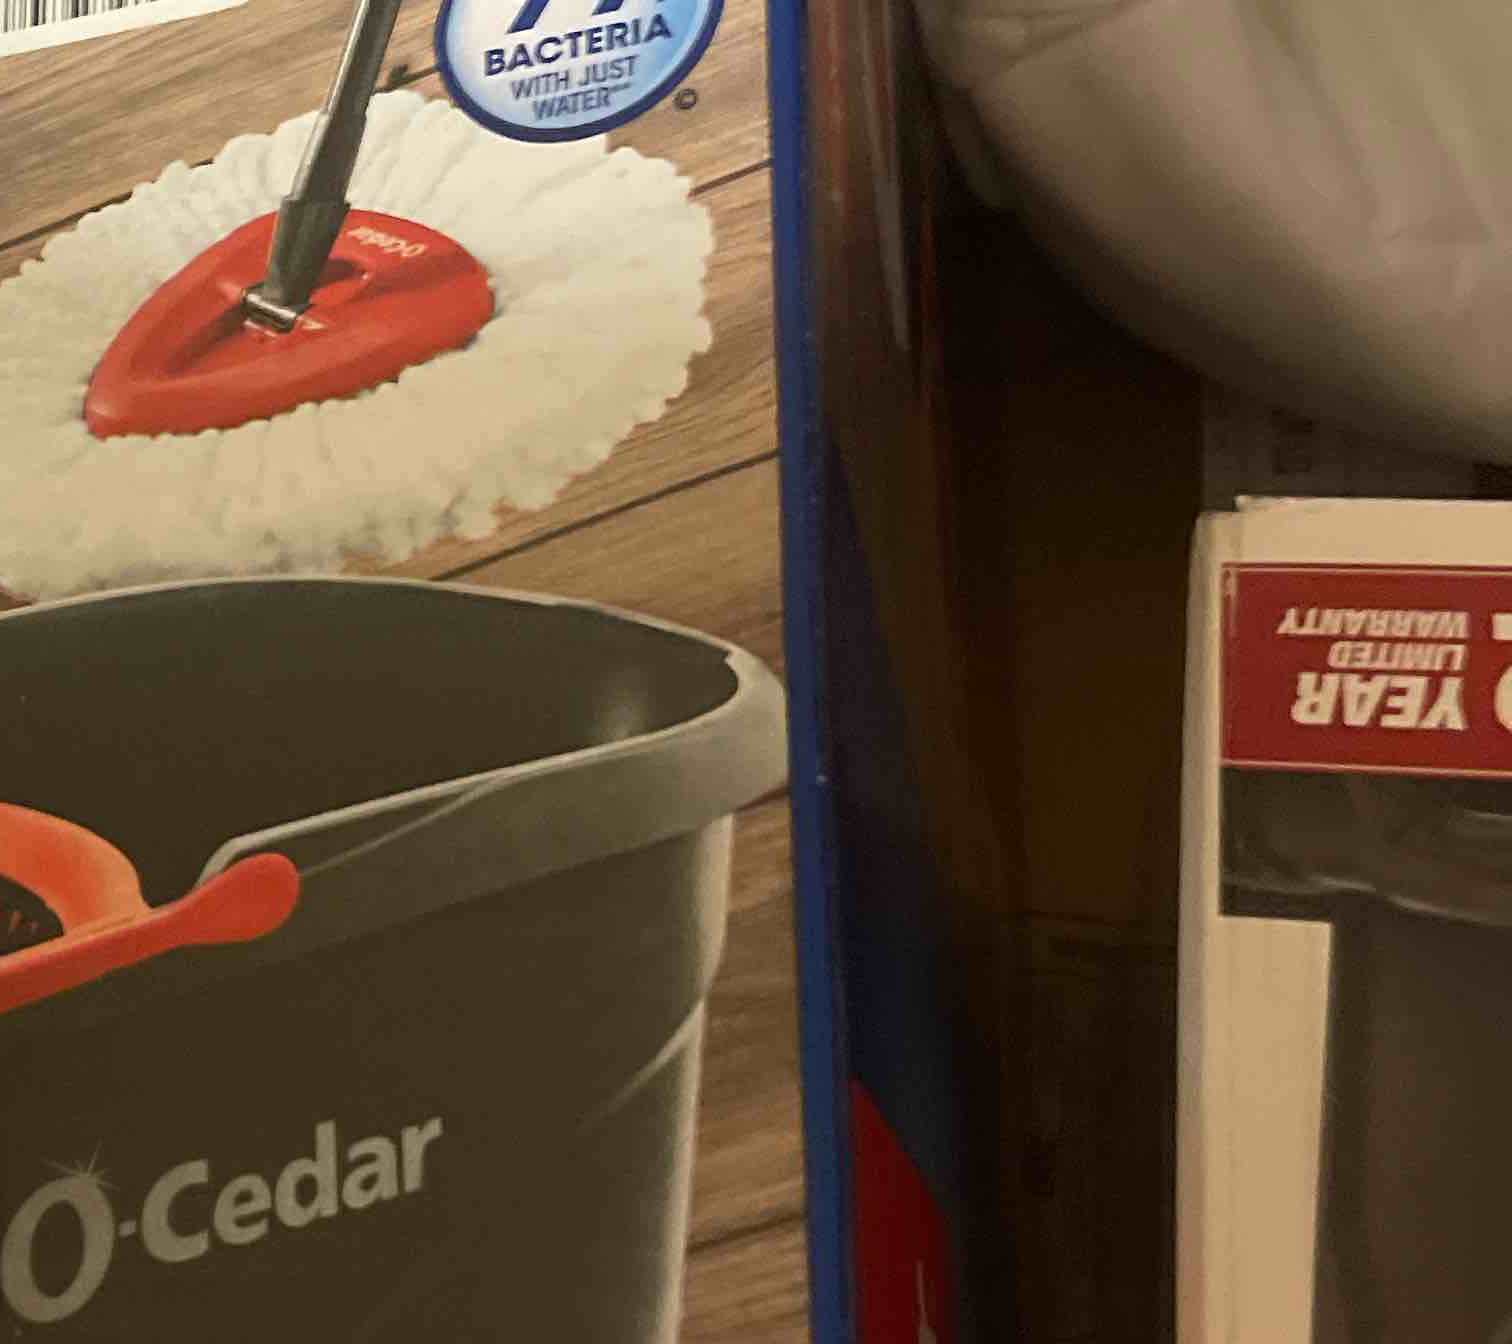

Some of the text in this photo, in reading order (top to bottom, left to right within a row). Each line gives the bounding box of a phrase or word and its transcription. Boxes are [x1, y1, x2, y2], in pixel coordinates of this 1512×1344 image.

[483, 14, 672, 77] BACTERIA
[511, 56, 638, 101] WITH JUST
[1277, 607, 1471, 641] WARRANTY
[1328, 641, 1468, 672] LIMITED
[1290, 671, 1469, 731] YEAR
[0, 1114, 444, 1325] O-Cedar
